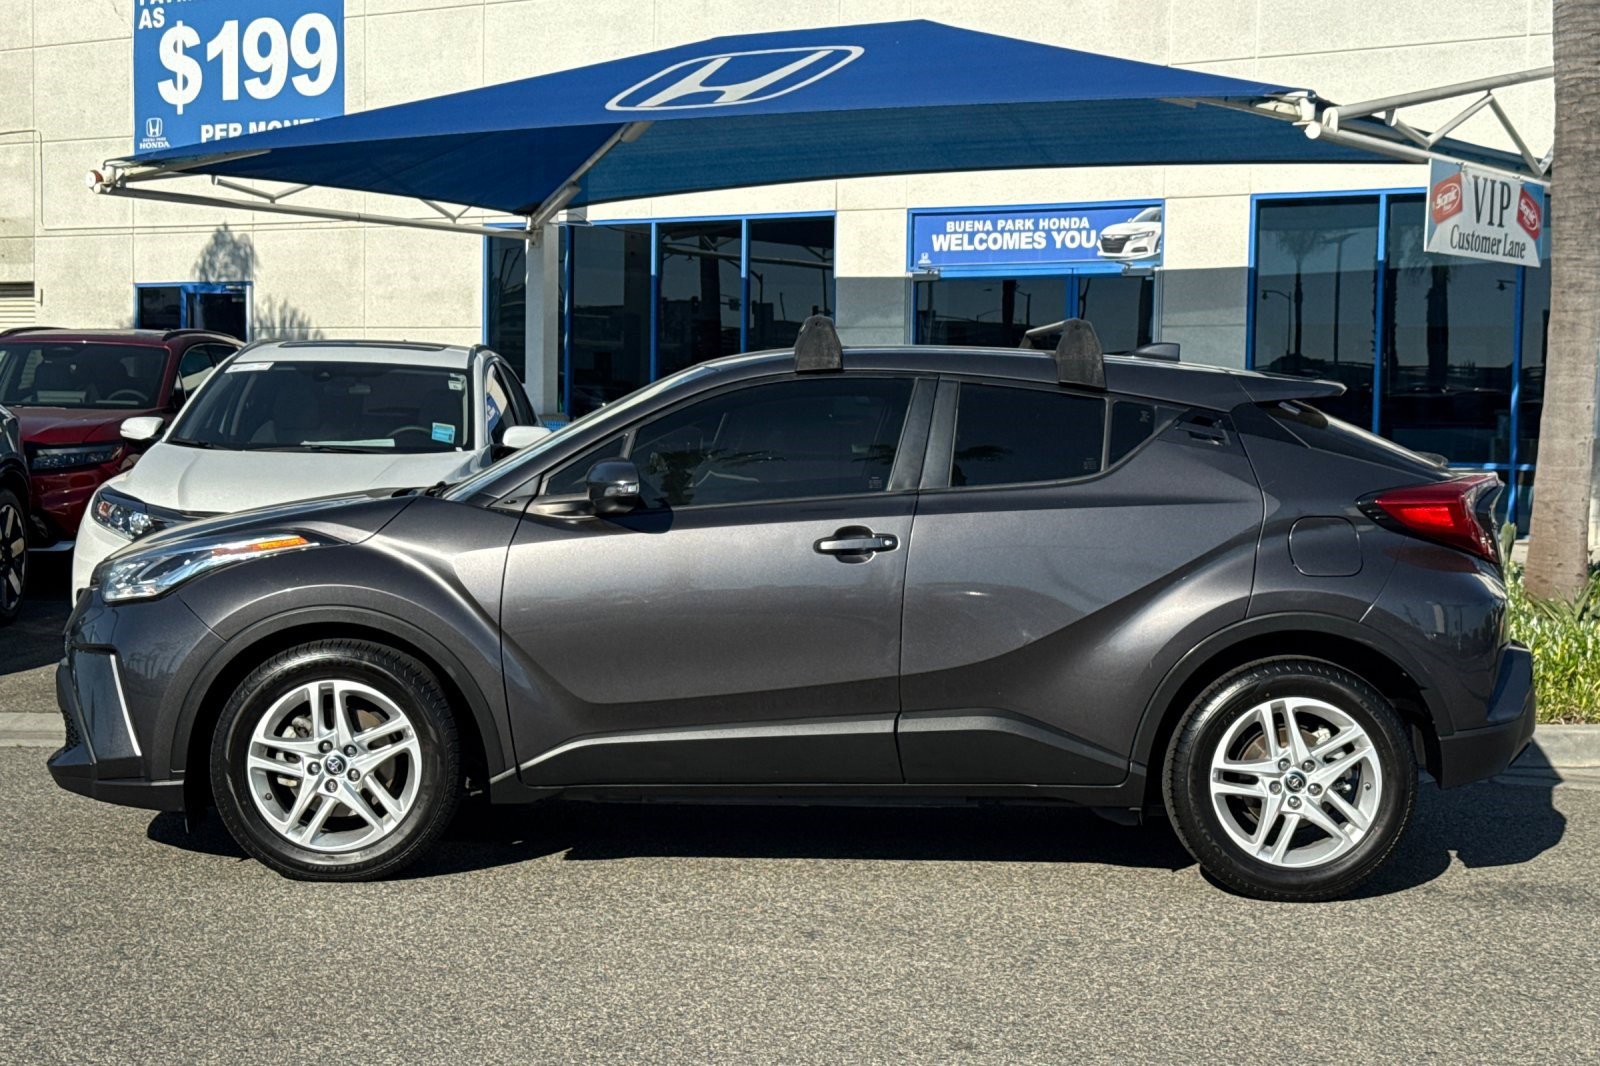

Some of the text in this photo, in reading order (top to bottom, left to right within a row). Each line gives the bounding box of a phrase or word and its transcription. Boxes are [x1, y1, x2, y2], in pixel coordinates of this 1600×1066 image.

[138, 7, 165, 29] AS
[157, 12, 338, 115] $199
[139, 141, 171, 149] HONDA
[1472, 174, 1511, 228] VIP
[946, 216, 1090, 232] BUENA PARK HONDA
[931, 229, 1097, 252] WELCOMES YOU
[1450, 224, 1526, 259] Customer Lane
